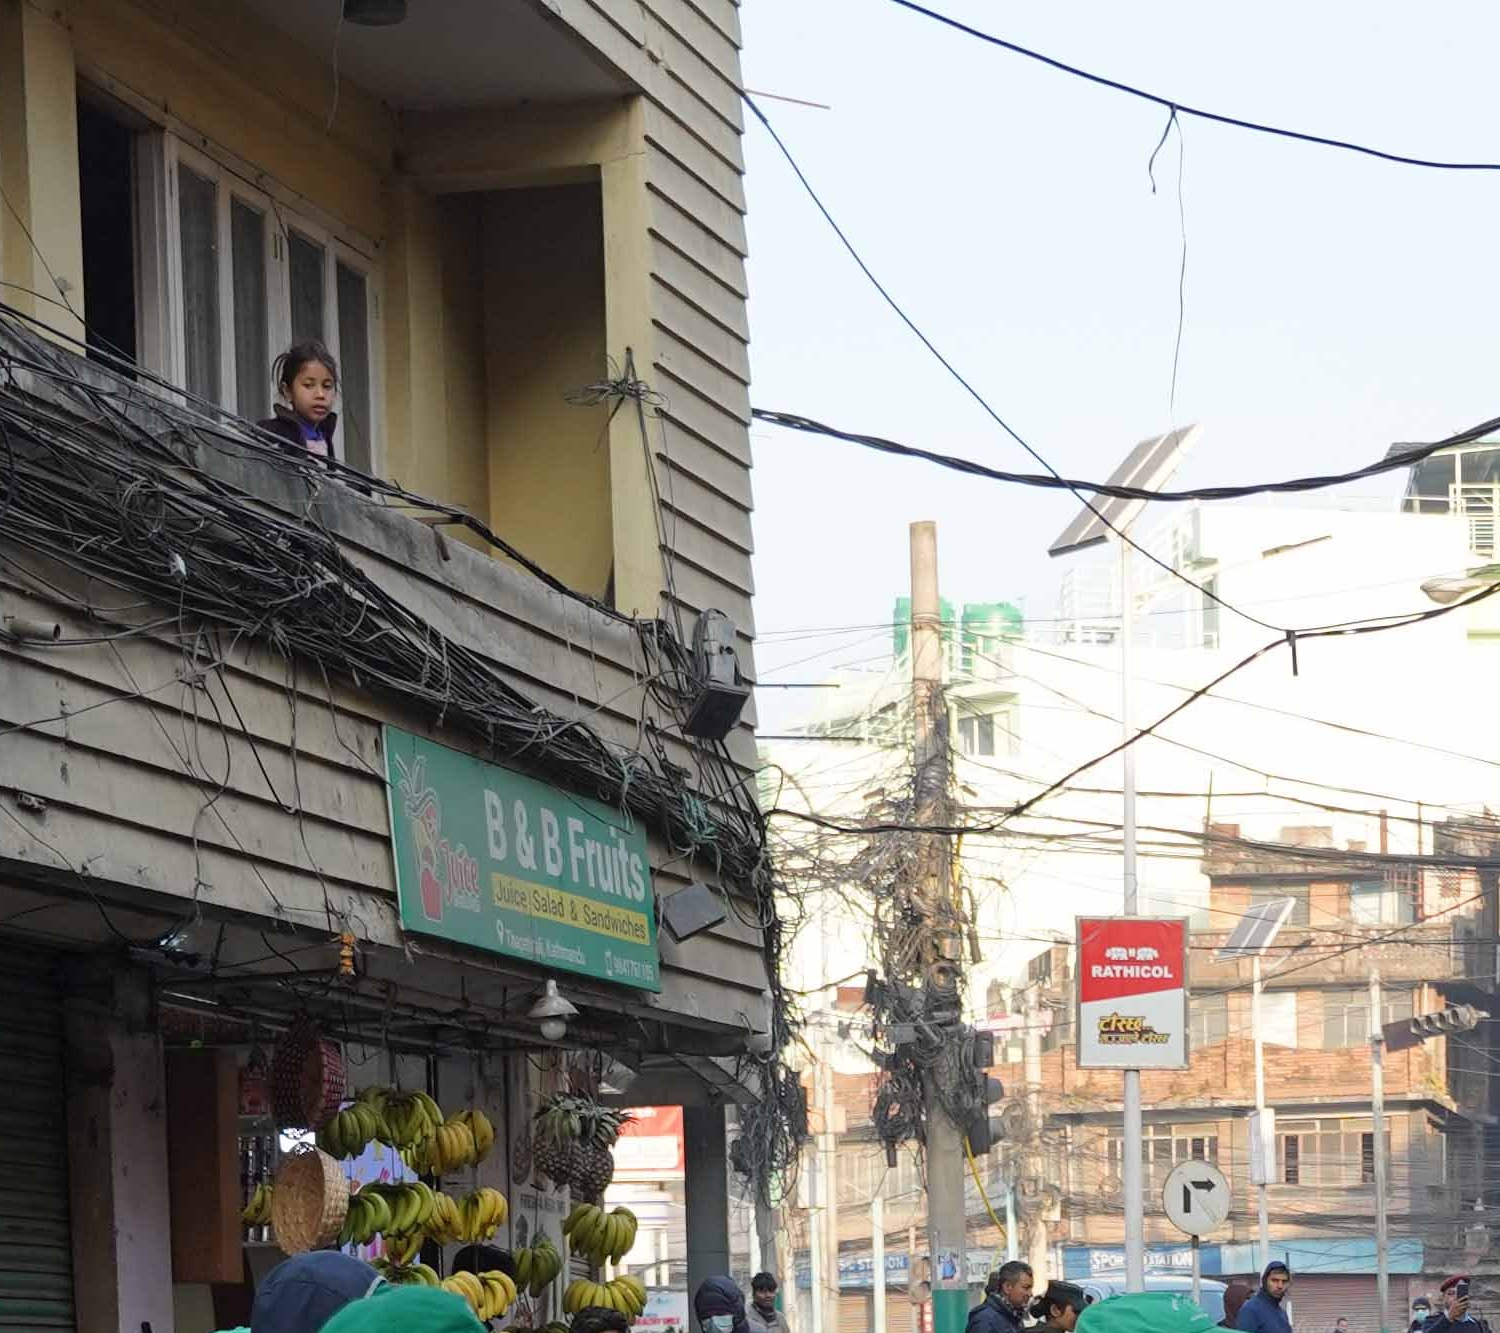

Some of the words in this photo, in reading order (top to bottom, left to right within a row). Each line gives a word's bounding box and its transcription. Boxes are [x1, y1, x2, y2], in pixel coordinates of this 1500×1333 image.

[484, 789, 507, 861] B
[514, 800, 538, 870] &
[540, 808, 563, 877] B
[567, 817, 645, 901] Fruits
[533, 890, 564, 918] Salad
[569, 901, 578, 920] &
[583, 904, 646, 939] Sandwiches
[1091, 965, 1173, 979] RATHICOL
